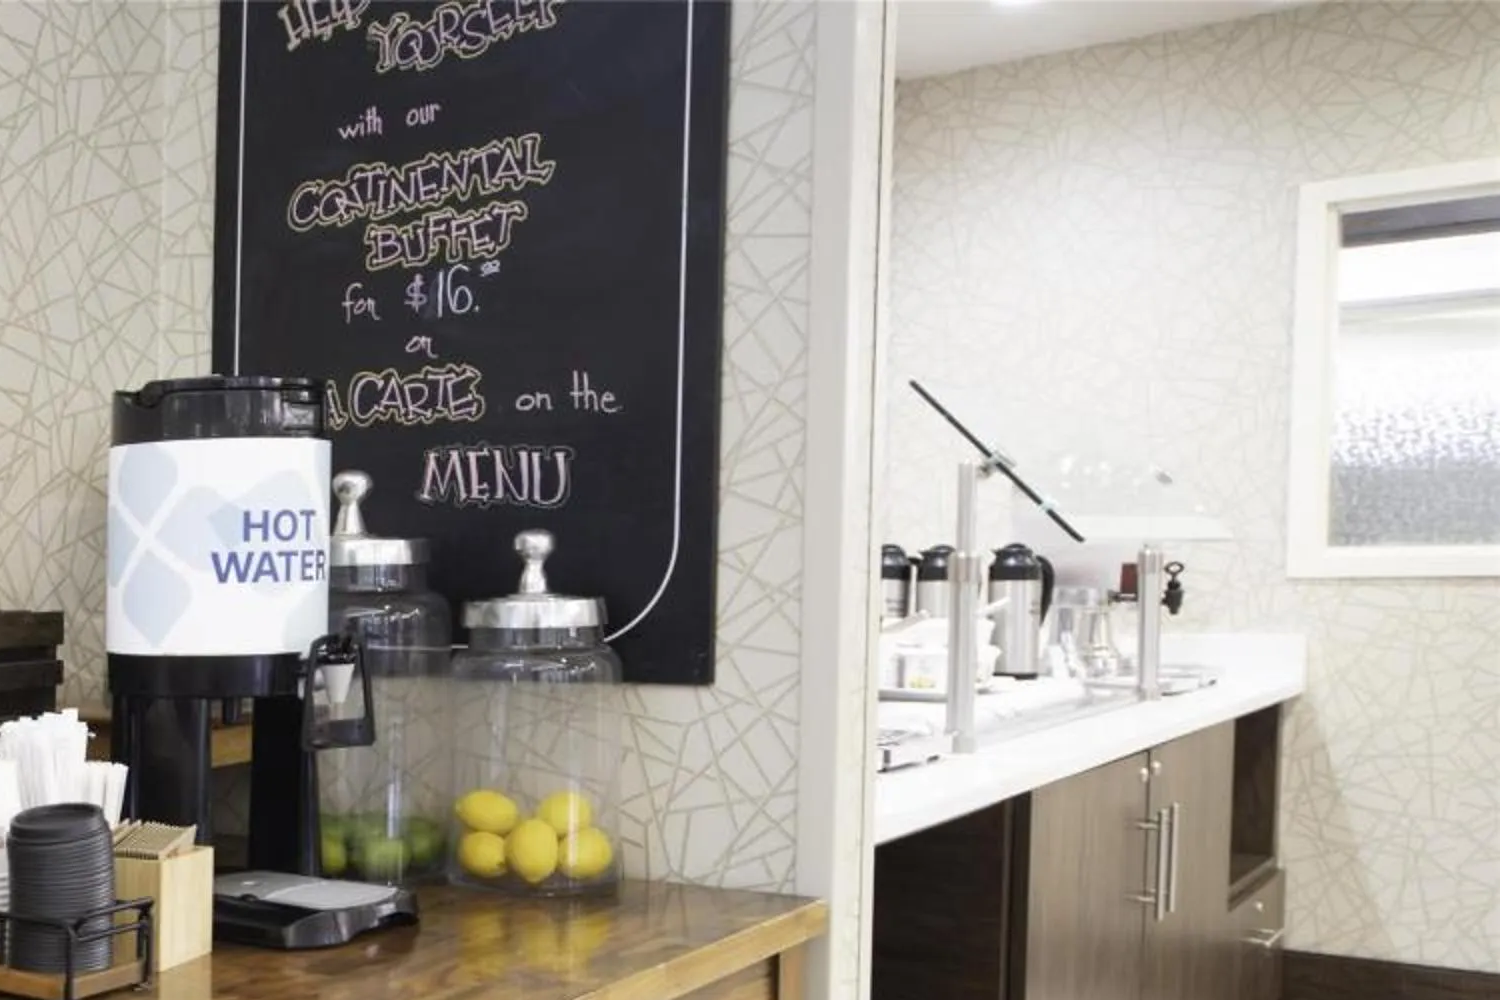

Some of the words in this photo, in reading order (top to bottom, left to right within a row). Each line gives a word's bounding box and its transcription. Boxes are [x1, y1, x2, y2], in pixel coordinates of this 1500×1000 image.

[338, 106, 383, 139] with
[405, 103, 441, 126] our
[288, 133, 556, 231] CONTINENTAL
[364, 200, 528, 271] BUFFET
[341, 283, 380, 323] for
[349, 363, 485, 427] CARTE
[514, 386, 552, 412] on
[570, 369, 624, 413] the
[415, 441, 577, 508] MENU
[242, 509, 317, 543] HOT
[210, 549, 327, 584] WATER
